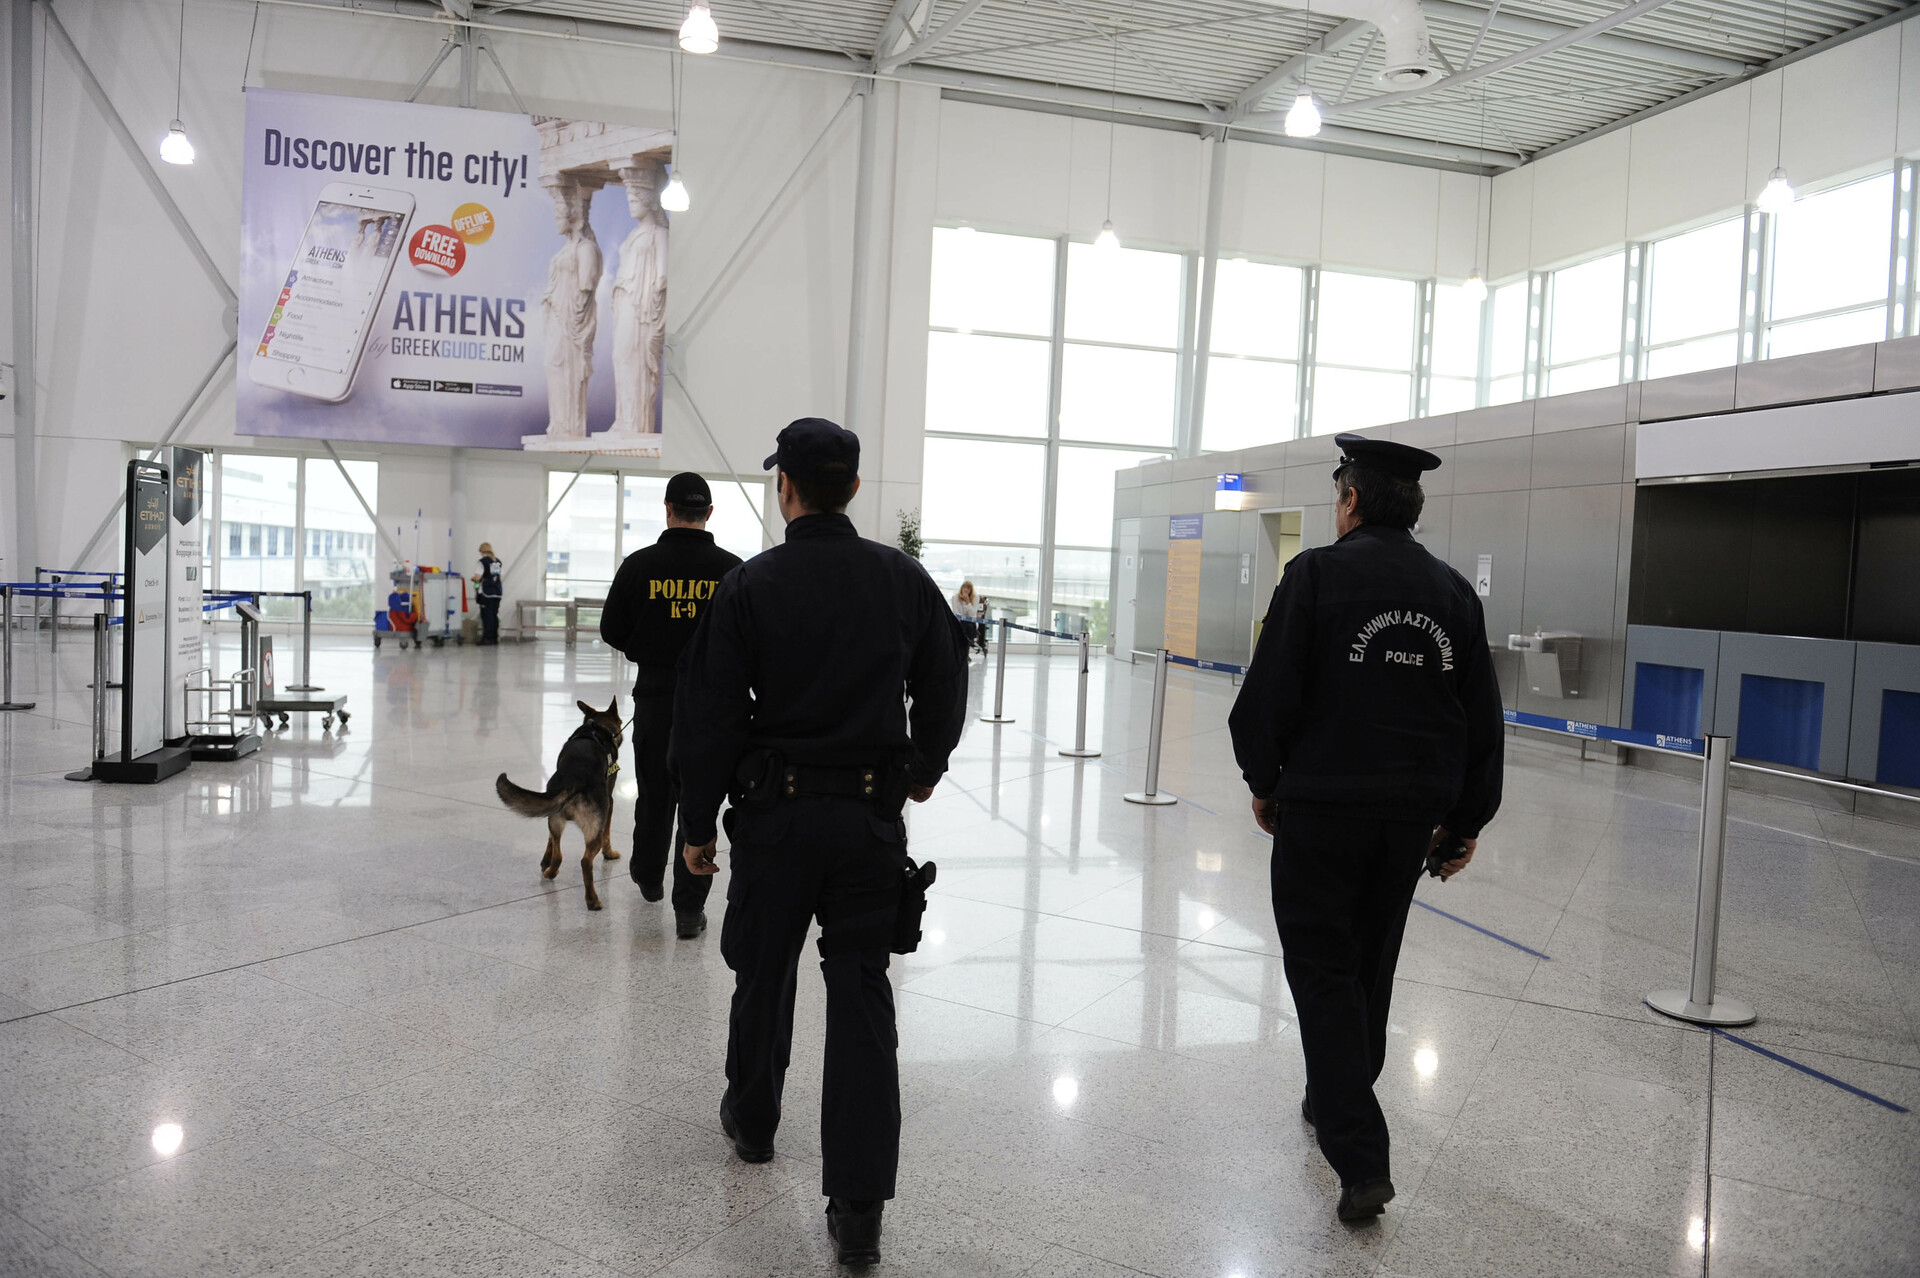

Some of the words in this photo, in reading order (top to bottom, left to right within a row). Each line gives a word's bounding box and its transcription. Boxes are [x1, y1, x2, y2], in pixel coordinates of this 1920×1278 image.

[264, 128, 396, 175] Discover
[404, 141, 453, 181] the
[464, 150, 528, 198] city!
[454, 211, 491, 231] OFFLINE
[421, 229, 458, 257] FREE
[308, 246, 347, 263] ATHENS
[414, 247, 457, 269] DOWNLOAD
[287, 311, 303, 320] Food
[392, 290, 526, 338] ATHENS
[272, 349, 301, 362] Shopping
[368, 336, 389, 359] by
[391, 337, 524, 363] GREEKGUIDE.COM
[140, 511, 165, 521] ETIHAD
[670, 601, 697, 619] K-9
[1349, 610, 1402, 663] ΕΛΛΗΝΙΚΗ
[1402, 610, 1454, 672] ΑΣΤΥΝΟΜΙΑ
[1574, 721, 1598, 731] ATHENS
[1665, 735, 1692, 745] ATHENS
